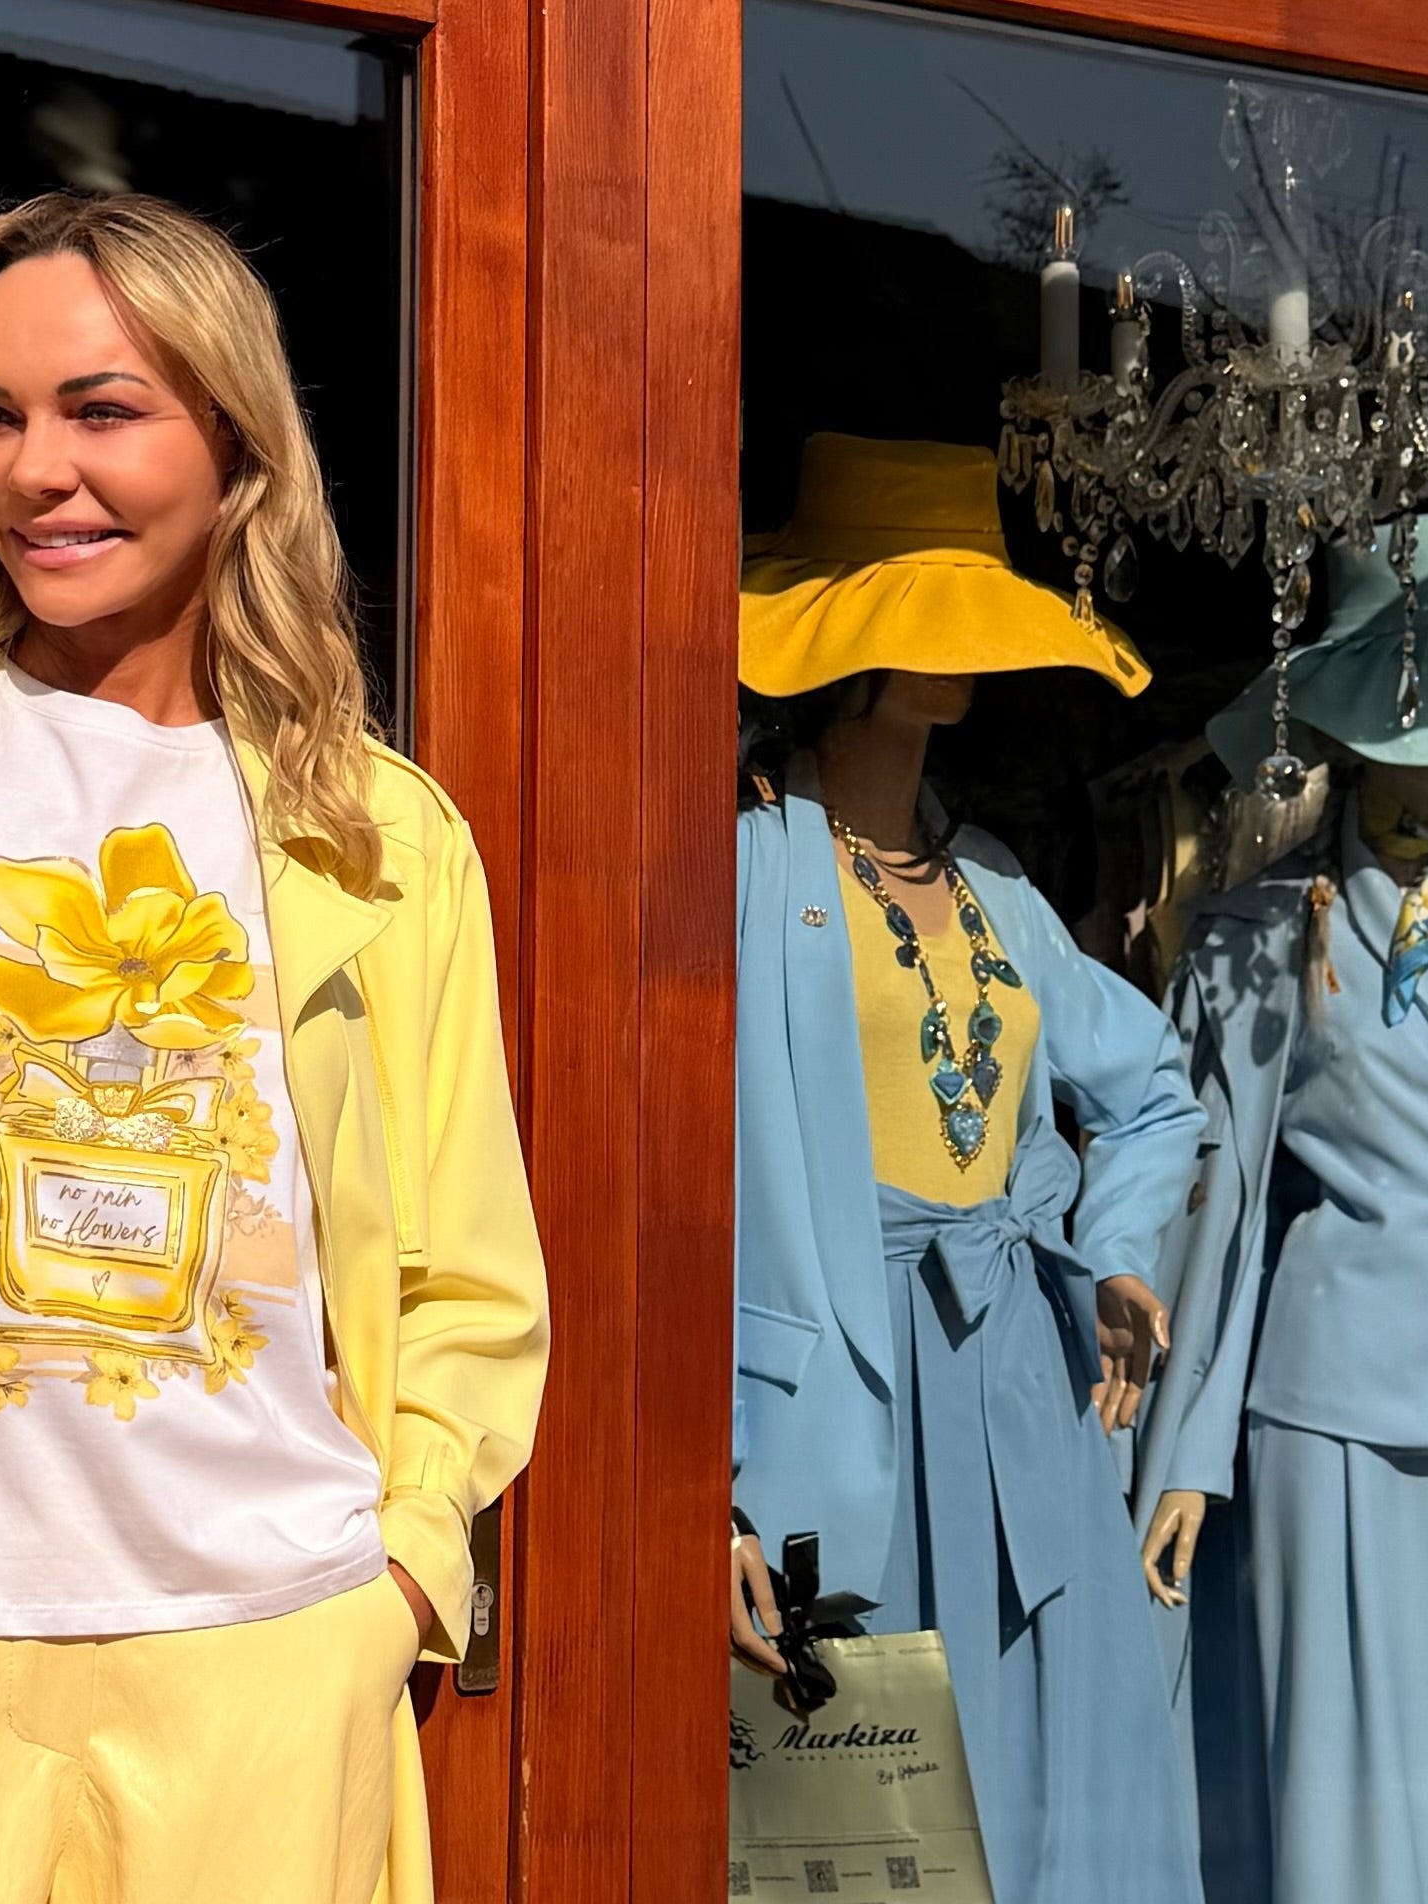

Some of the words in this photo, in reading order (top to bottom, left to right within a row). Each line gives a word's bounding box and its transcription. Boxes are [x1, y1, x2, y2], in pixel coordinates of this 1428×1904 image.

[59, 1183, 87, 1200] no
[40, 1214, 64, 1230] no
[64, 1207, 162, 1248] flowers
[772, 1722, 921, 1750] Markiza
